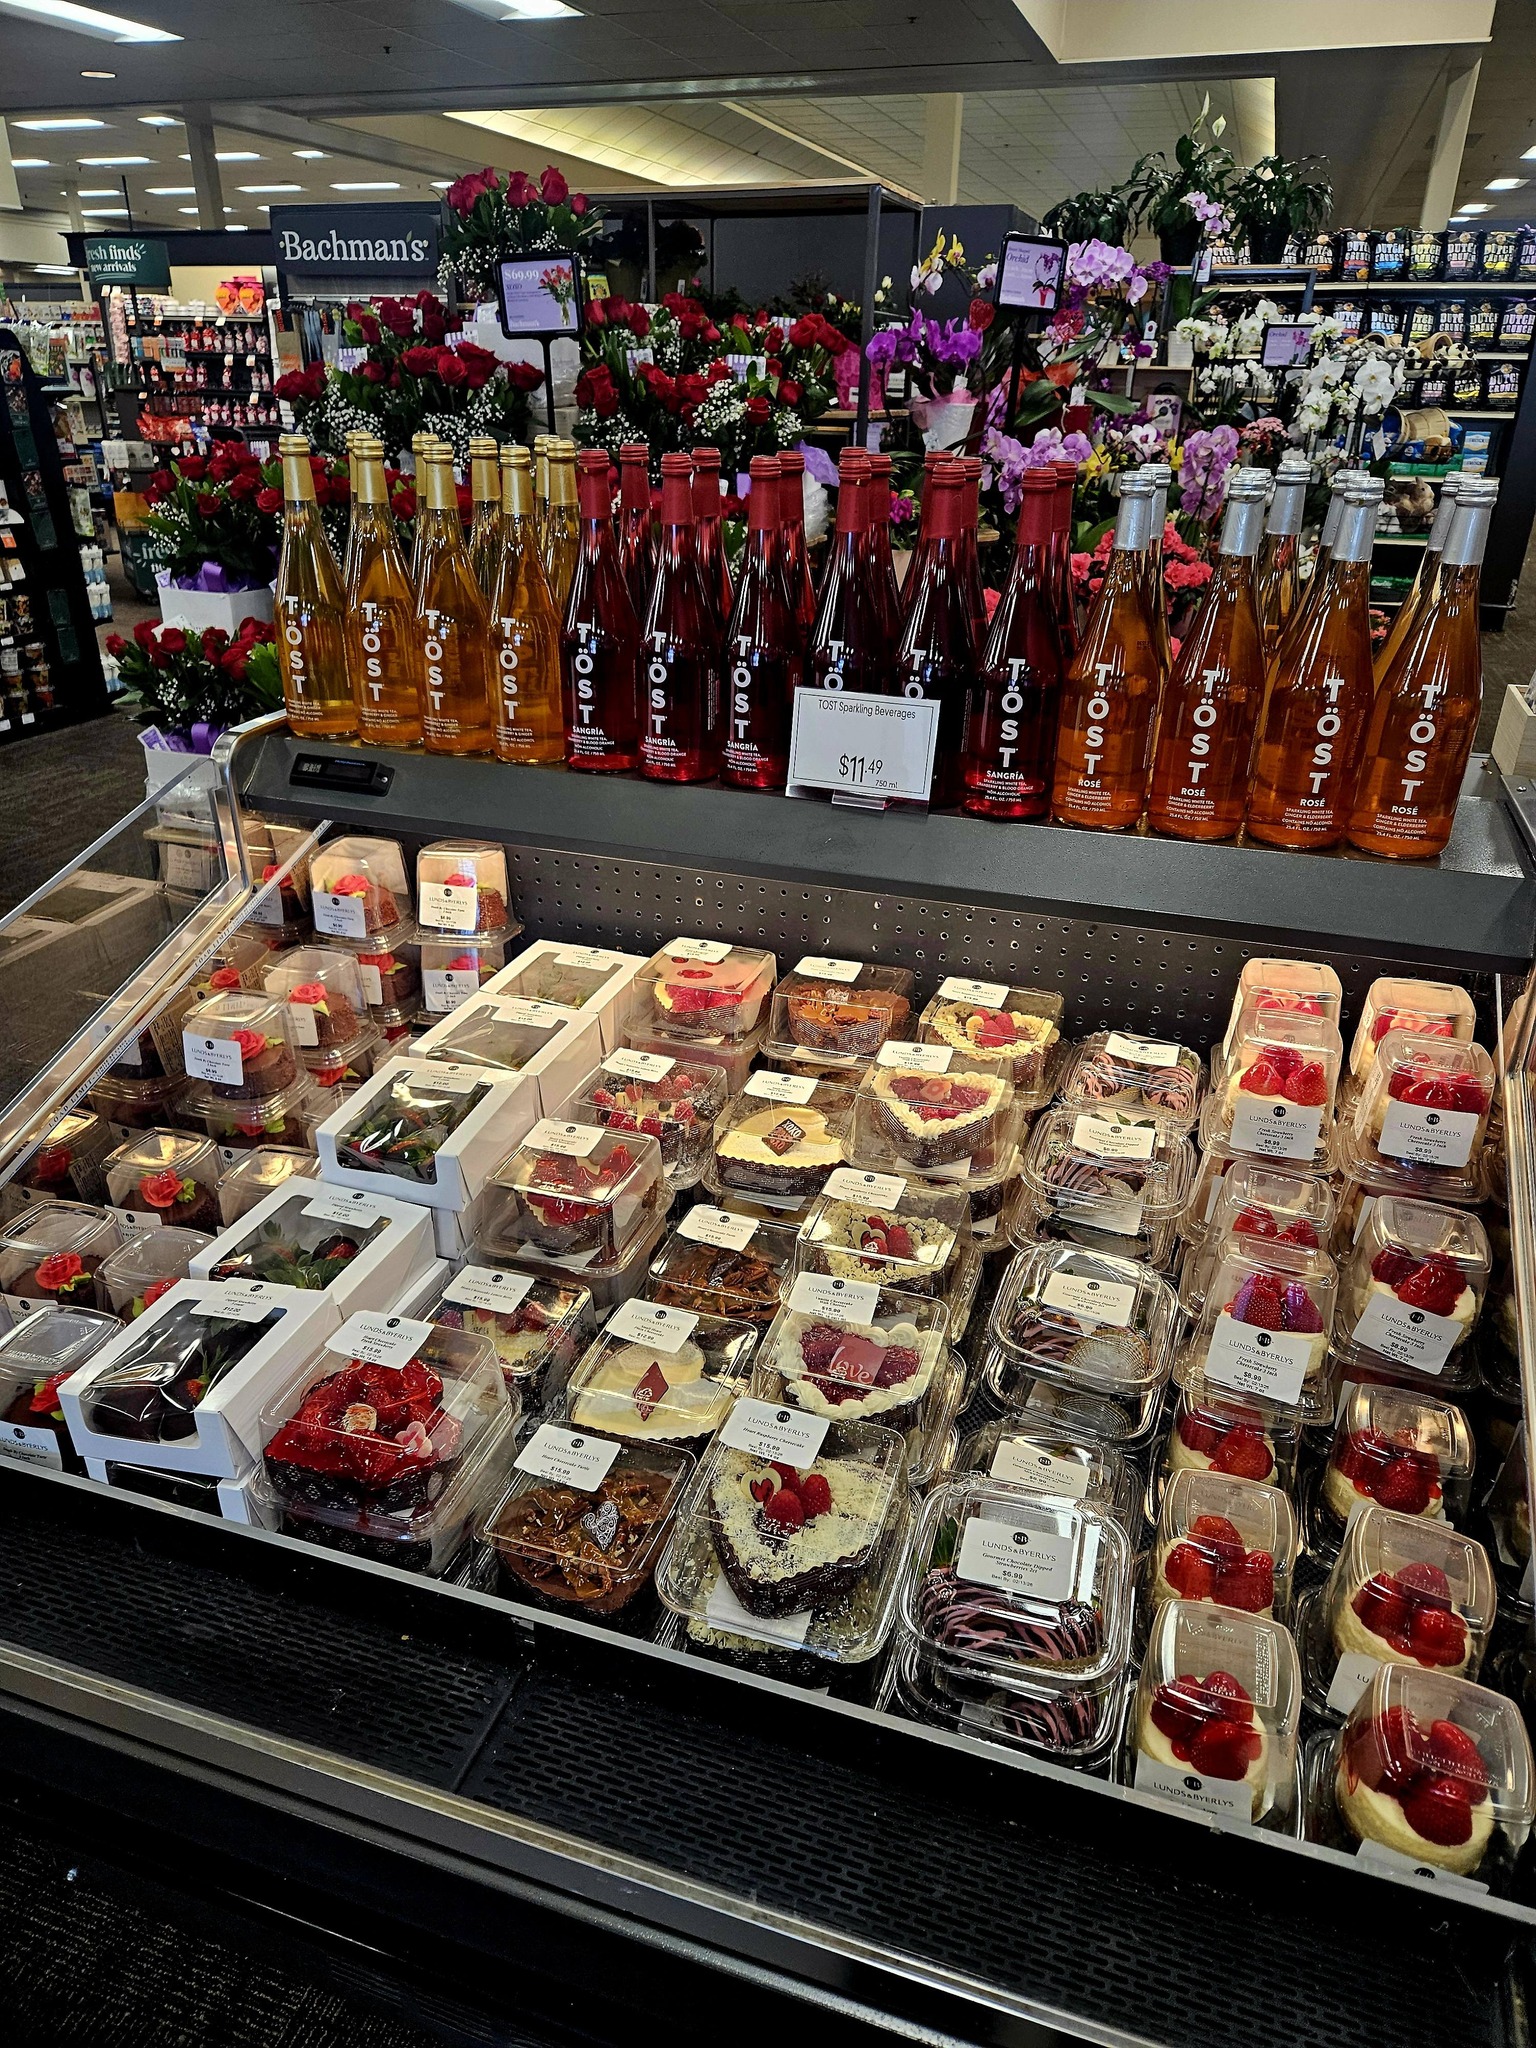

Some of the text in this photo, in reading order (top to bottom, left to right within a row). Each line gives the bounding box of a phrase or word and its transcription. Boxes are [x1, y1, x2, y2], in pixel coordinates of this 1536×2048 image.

[109, 245, 141, 260] finds
[282, 230, 426, 261] Bachman's
[1411, 244, 1441, 255] DUTCH
[103, 261, 137, 272] arrivals
[1006, 253, 1030, 264] Orchid
[504, 268, 539, 280] $69.99
[1504, 314, 1536, 326] DUTCH
[1500, 325, 1533, 334] CRUNCH
[285, 596, 307, 694] TÖST
[361, 602, 384, 702] TÖST
[425, 609, 445, 710] TÖST
[823, 640, 844, 690] TÖ
[500, 618, 520, 720] TÖST
[575, 622, 595, 723] TÖST
[904, 649, 926, 699] TÖ
[648, 632, 667, 734] TÖST
[732, 636, 752, 738] TÖST
[819, 699, 916, 720] TOST Sparkling Beverages
[998, 658, 1025, 768] TÖST
[1084, 663, 1112, 774] TÖST
[1187, 669, 1221, 783] TÖST
[572, 726, 604, 736] SANGRÍA
[1309, 678, 1345, 794] TÖST
[645, 736, 676, 746] SANGRÍA
[727, 740, 758, 751] SANGRÍA
[1400, 684, 1441, 801] TÖST
[838, 753, 883, 783] $11.49
[986, 770, 1024, 780] SANGRÍA
[1078, 779, 1101, 788] ROSÉ
[1181, 787, 1206, 797] ROSÉ
[1300, 798, 1325, 807] ROSÉ
[1391, 805, 1418, 815] ROSÉ
[782, 1120, 802, 1137] XOXO
[1250, 1115, 1307, 1129] LUNDS&BYERLYS
[1400, 1122, 1461, 1137] LUNDS&BYERLYS
[469, 1279, 516, 1292] LUNDS&BYERLYS
[808, 1287, 864, 1300] LUNDS&BYERLYS
[1063, 1286, 1120, 1302] LUNDS&BYERLYS
[632, 1314, 680, 1331] LUNDS&BYERLYS
[1381, 1313, 1442, 1342] LUNDS&BYERLYS
[360, 1324, 413, 1341] LUNDS&BYERLYS
[1385, 1331, 1411, 1346] Cheesecake
[1389, 1328, 1425, 1345] Fresh Strawberry
[1229, 1340, 1294, 1365] LUNDS&BYERLYS
[1390, 1342, 1408, 1352] $8.99
[1236, 1360, 1262, 1372] Cheesecake
[1254, 1360, 1277, 1372] Strawberry
[1244, 1371, 1262, 1381] $8.99
[748, 1416, 811, 1439] LUNDS&BYERLYS
[756, 1432, 778, 1441] Raspberry
[779, 1437, 805, 1448] Cheesecake
[759, 1441, 780, 1451] $15.99
[544, 1442, 600, 1462] LUNDS&BYERLYS
[550, 1466, 570, 1475] $15.99
[1012, 1456, 1075, 1481] LUNDS&BYERLYS
[983, 1540, 1056, 1562] LUNDS&BYERLYS
[983, 1552, 1005, 1561] Gourmet
[1007, 1557, 1032, 1568] Chocolate
[996, 1561, 1028, 1571] Strawberries
[1002, 1570, 1023, 1579] $6.99
[1154, 1782, 1234, 1807] LUNDS&BYERLYS
